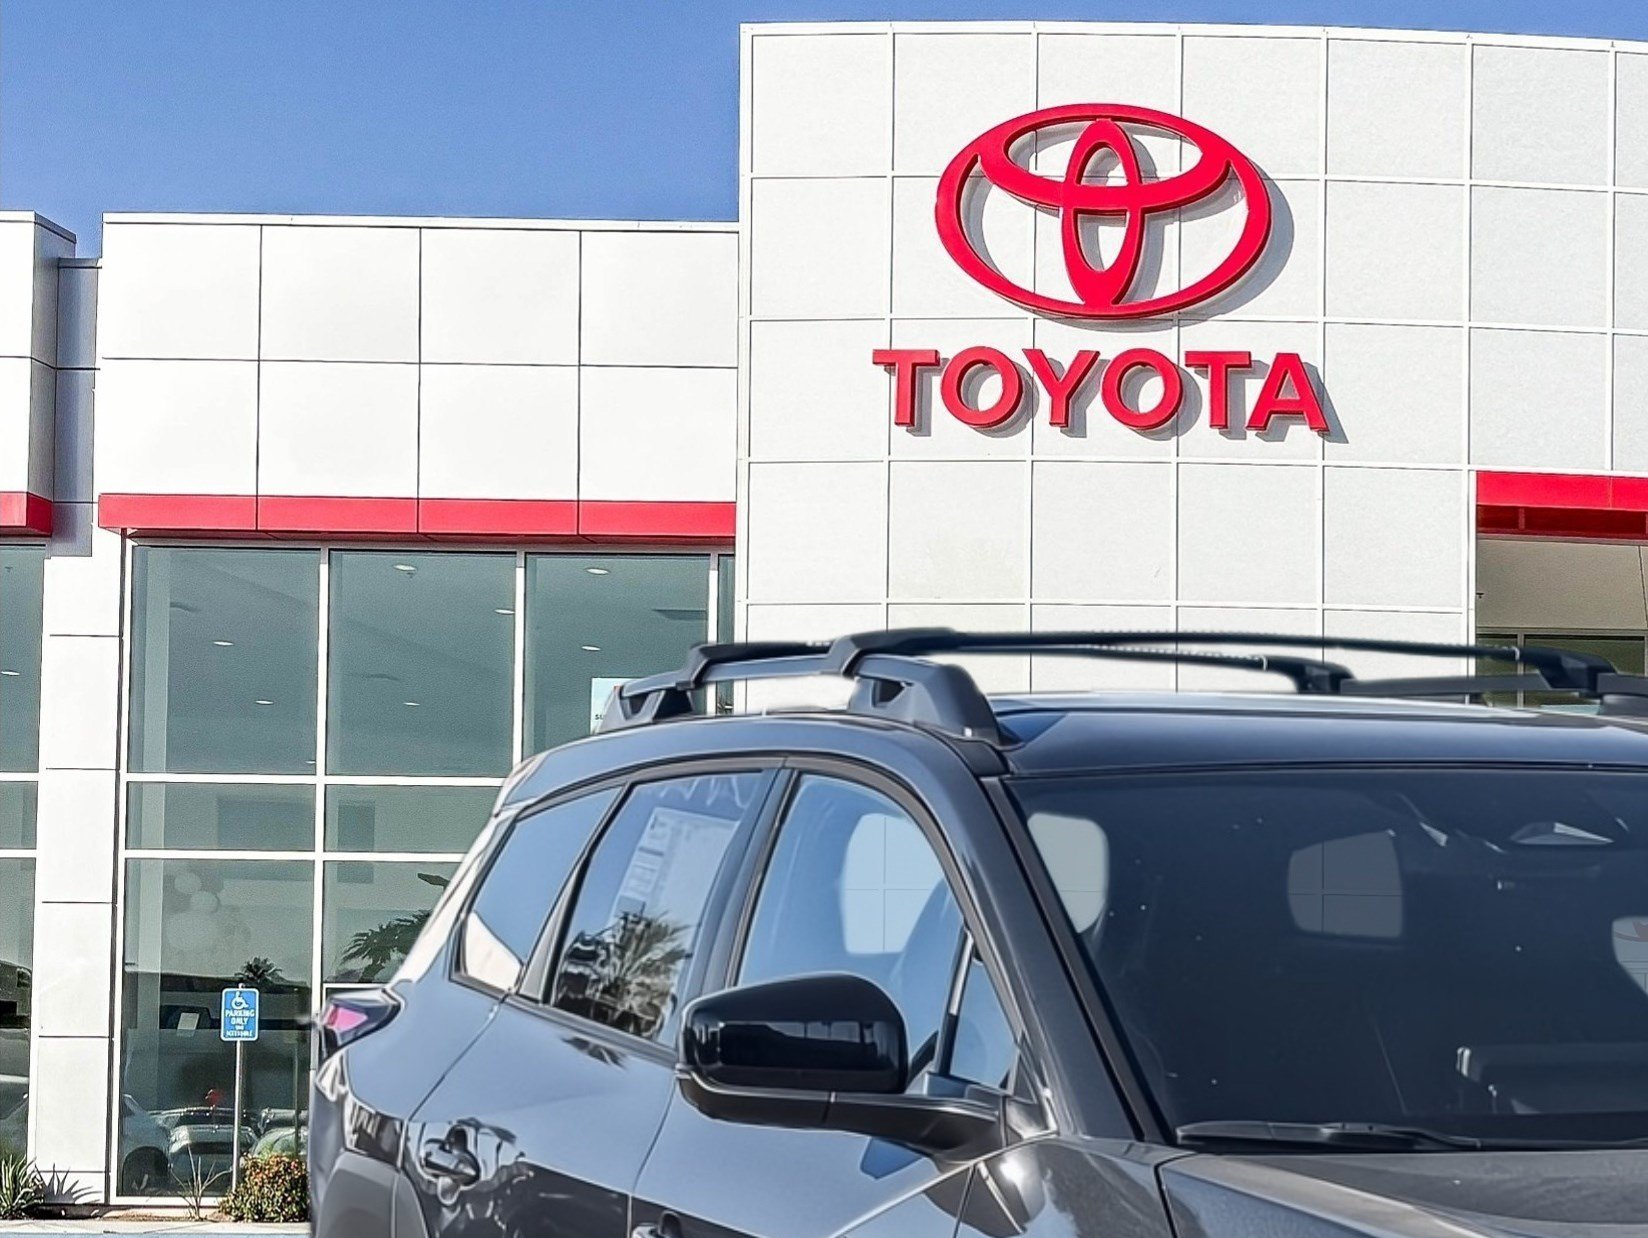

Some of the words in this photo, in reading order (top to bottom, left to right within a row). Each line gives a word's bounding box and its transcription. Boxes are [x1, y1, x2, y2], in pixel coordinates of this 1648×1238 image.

[872, 346, 1330, 432] TOYOTA
[225, 1009, 255, 1017] PARKING
[230, 1017, 248, 1025] ONLY
